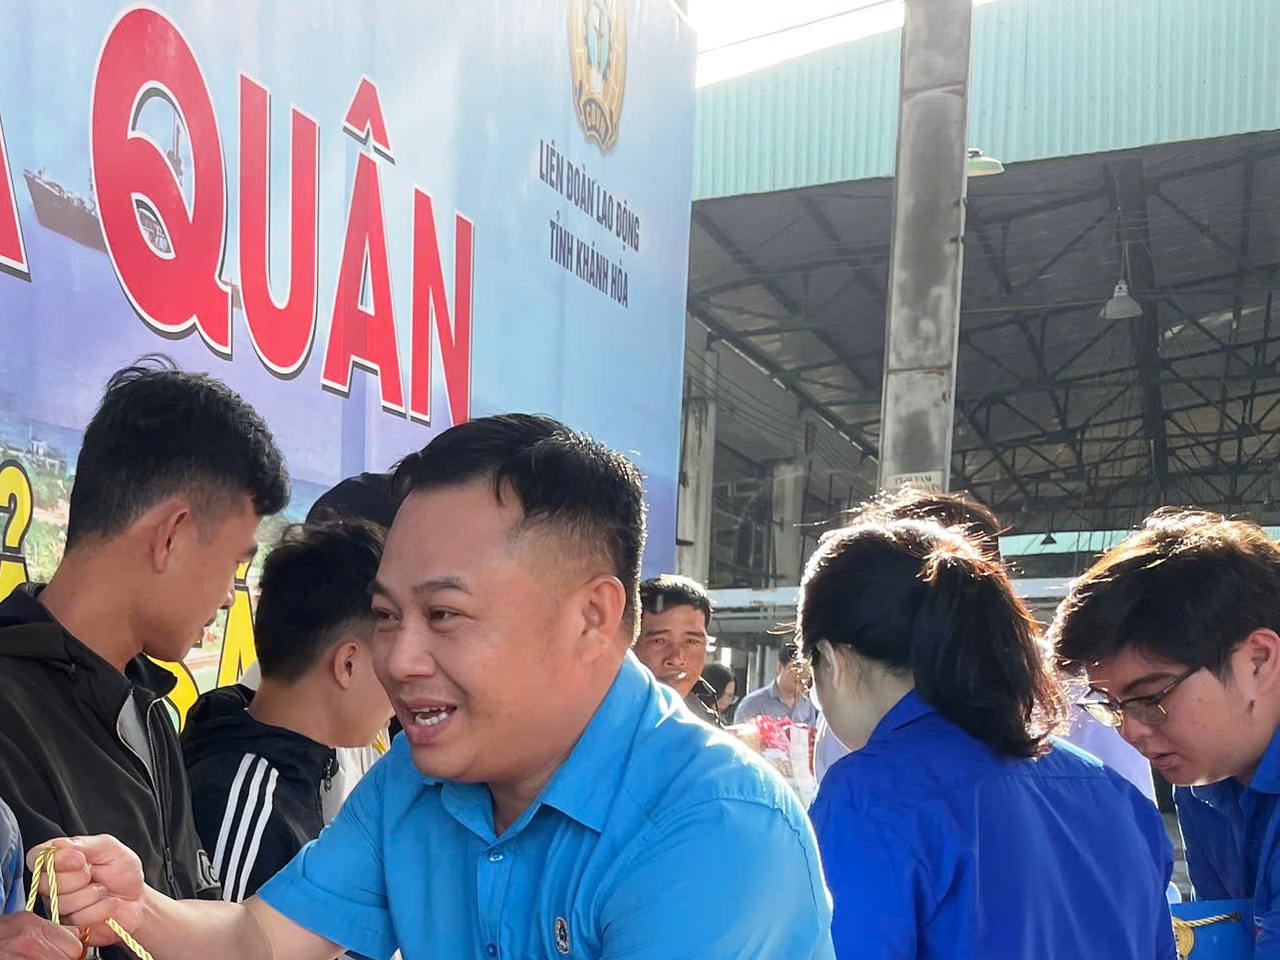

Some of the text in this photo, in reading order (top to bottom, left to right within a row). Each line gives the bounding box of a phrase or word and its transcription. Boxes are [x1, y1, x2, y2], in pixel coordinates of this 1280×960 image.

[91, 3, 475, 425] QUÂN
[539, 138, 640, 252] LIÊN ĐOÀN LAO ĐỘNG
[549, 209, 629, 308] TỈNH KHÁNH HÒA
